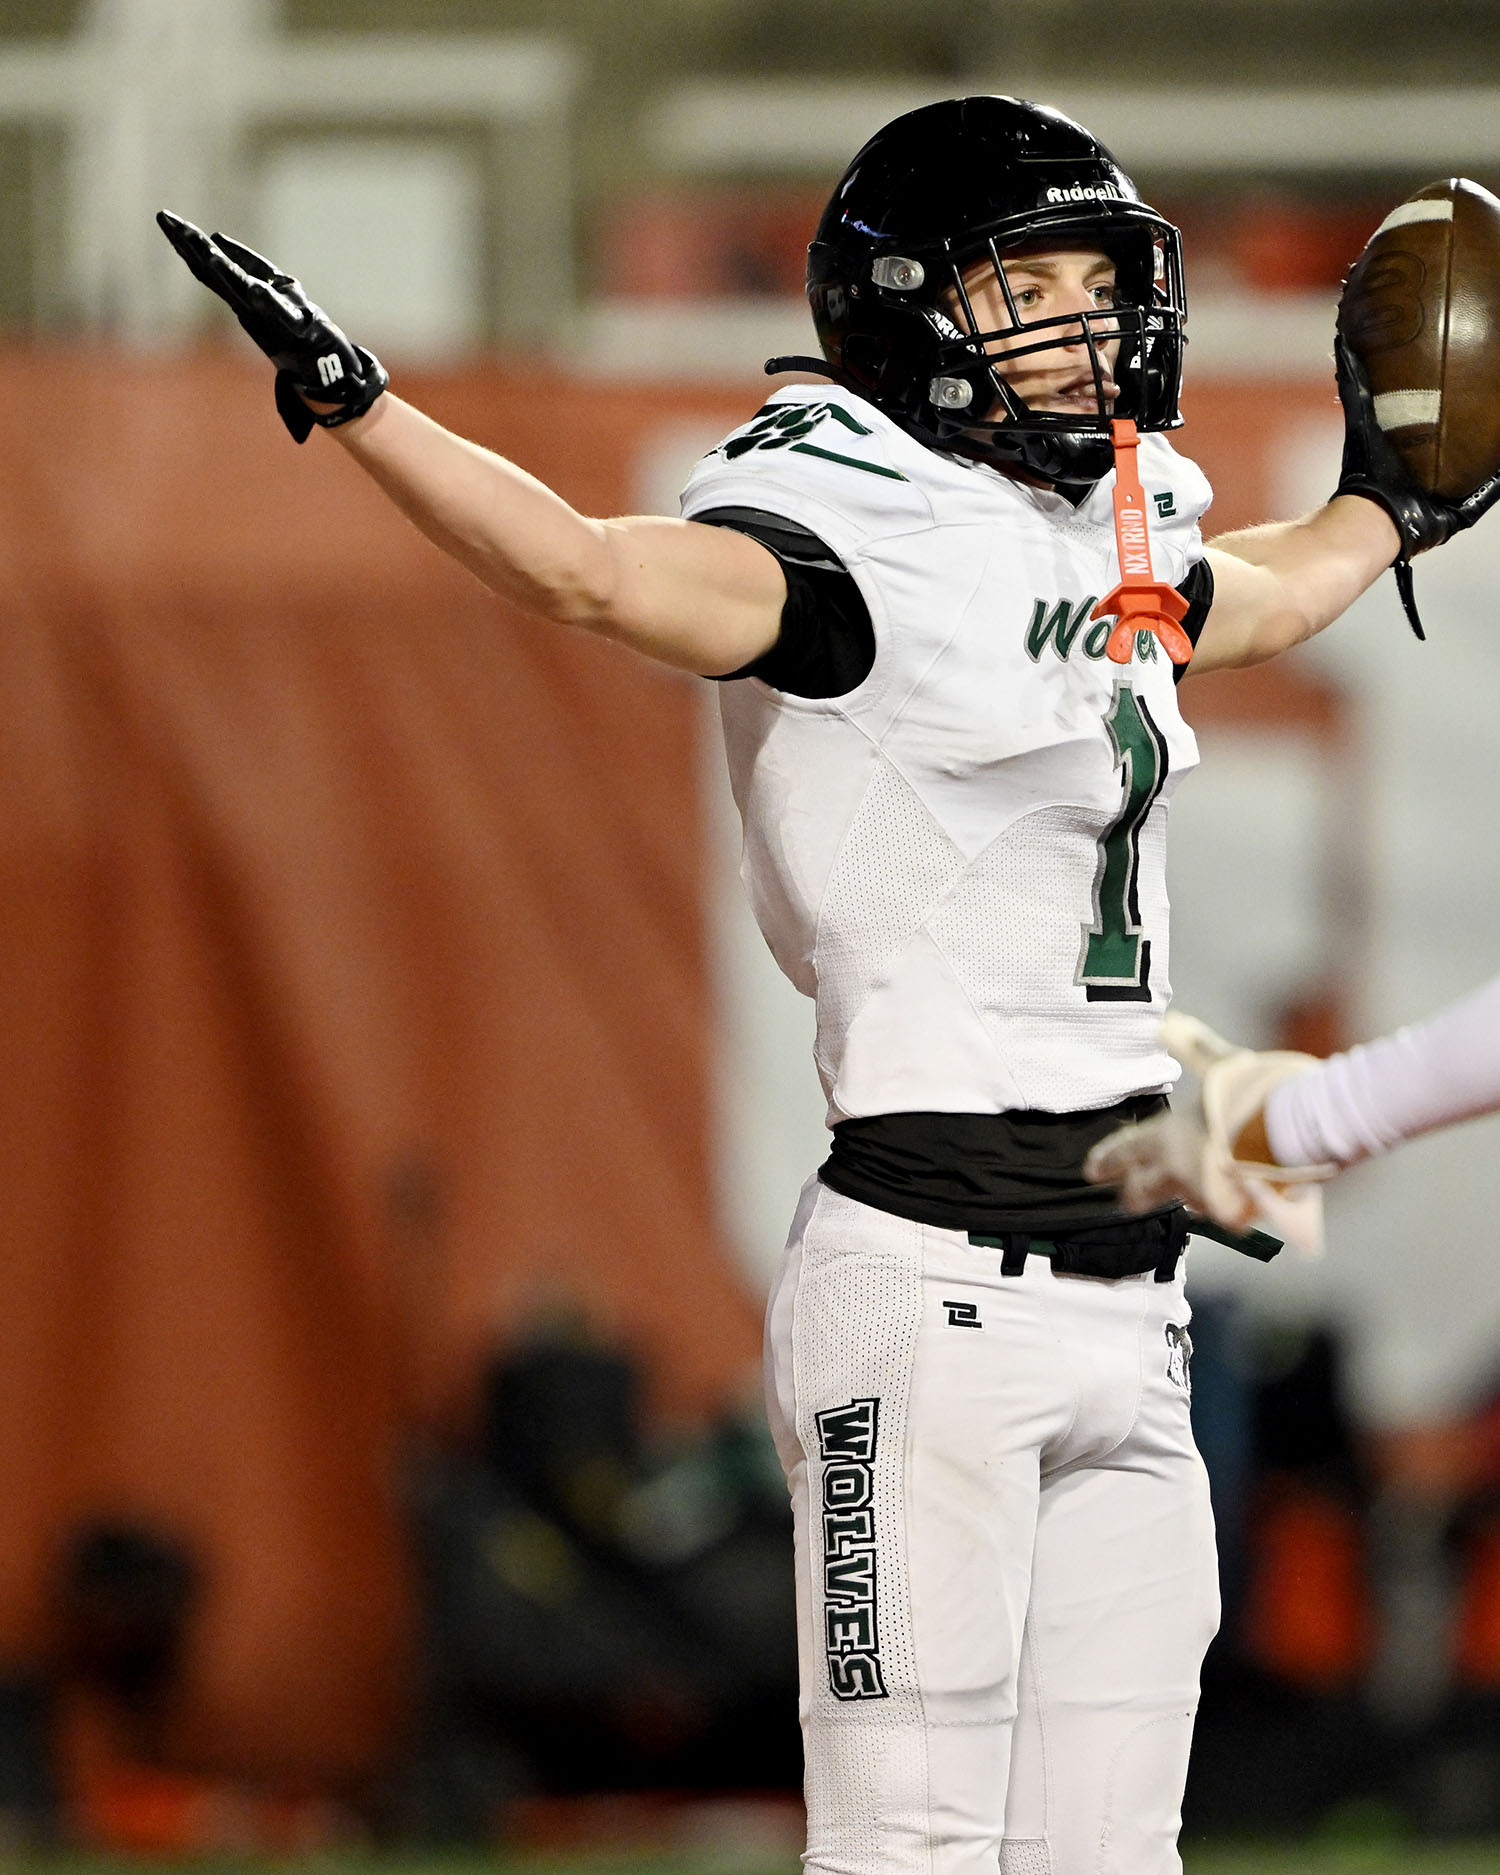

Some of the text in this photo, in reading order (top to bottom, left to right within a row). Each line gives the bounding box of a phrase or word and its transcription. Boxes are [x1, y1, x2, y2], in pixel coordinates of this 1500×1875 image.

[1119, 508, 1150, 575] NXTRND
[1073, 679, 1171, 1003] 1
[815, 1397, 889, 1701] WOLVES
